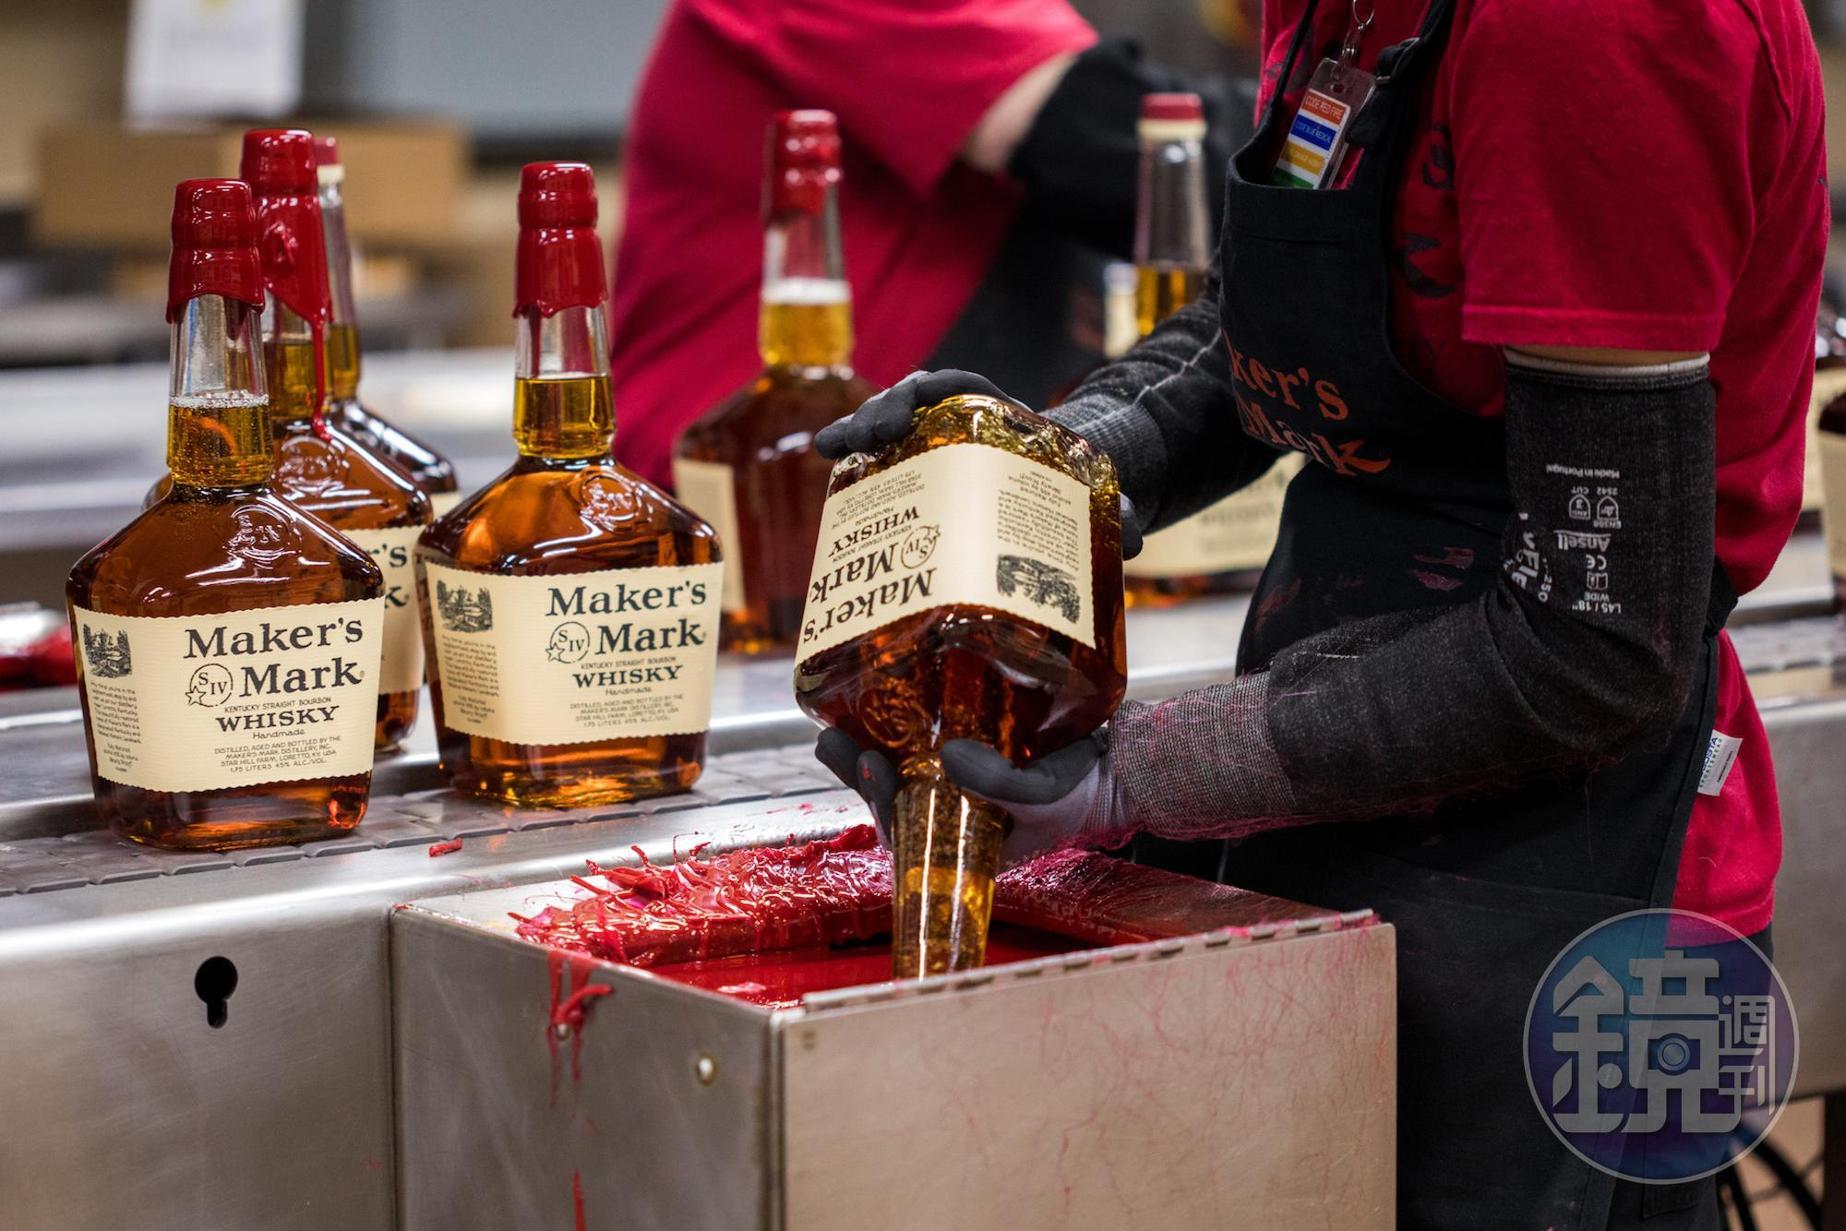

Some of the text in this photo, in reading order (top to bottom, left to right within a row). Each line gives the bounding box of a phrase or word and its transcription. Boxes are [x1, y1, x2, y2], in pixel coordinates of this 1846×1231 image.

[1221, 328, 1349, 421] ker's
[1546, 464, 1620, 479] Made in Portugal
[1571, 486, 1589, 494] CUT
[828, 505, 921, 558] WHISKY
[1557, 534, 1611, 552] Ansell
[811, 542, 899, 604] Mark
[1585, 554, 1607, 570] CE
[545, 580, 707, 617] Maker's
[803, 567, 937, 644] Maker's
[1585, 592, 1610, 601] WIDE
[1603, 602, 1622, 614] L45
[183, 617, 363, 659] Maker's
[595, 618, 704, 655] Mark
[239, 656, 362, 698] Mark
[572, 664, 683, 688] WHISKY
[224, 696, 332, 713] KENTUCKY STRAIGHT BOURBON
[215, 705, 340, 733] WHISKY
[253, 728, 306, 740] Handmade
